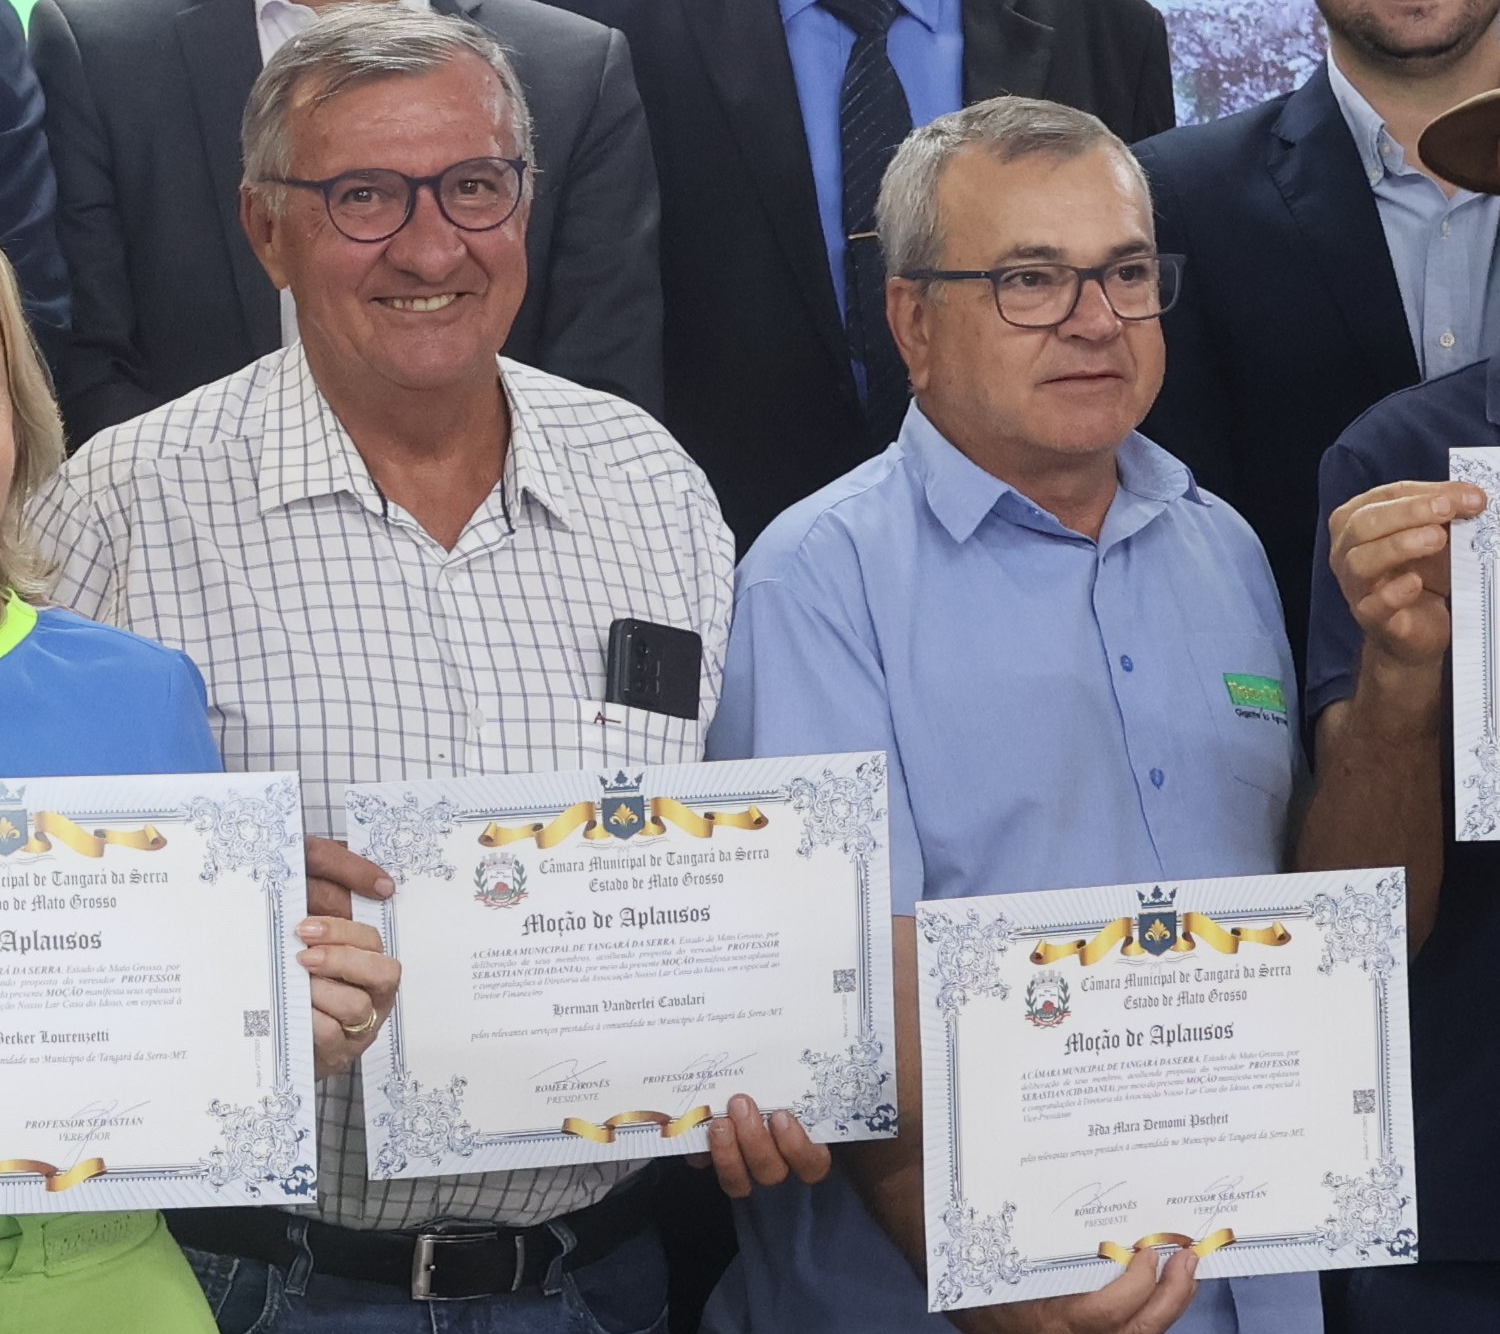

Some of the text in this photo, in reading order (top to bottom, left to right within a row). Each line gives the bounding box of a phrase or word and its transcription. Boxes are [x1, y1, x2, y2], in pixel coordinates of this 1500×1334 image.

[539, 847, 769, 874] Câmara Municipal de Tangará da Serra
[33, 873, 46, 886] de
[52, 871, 106, 888] Tangará
[111, 871, 125, 884] da
[130, 869, 168, 884] Serra
[13, 897, 26, 910] de
[31, 895, 65, 911] Mato
[70, 894, 116, 909] Grosso
[522, 905, 710, 936] Moção de Aplausos
[0, 930, 101, 955] Aplausos
[1081, 964, 1291, 992] Câmara Municipal de Tangará da Serra
[602, 998, 654, 1012] Vanderlei
[658, 994, 704, 1008] Cavalari
[40, 1031, 109, 1043] Lourenzetti
[1064, 1022, 1233, 1056] Moção de Aplausos
[25, 1119, 84, 1130] PROFESSOR
[86, 1117, 144, 1129] SEBASTIAN
[1113, 1122, 1140, 1134] Mara
